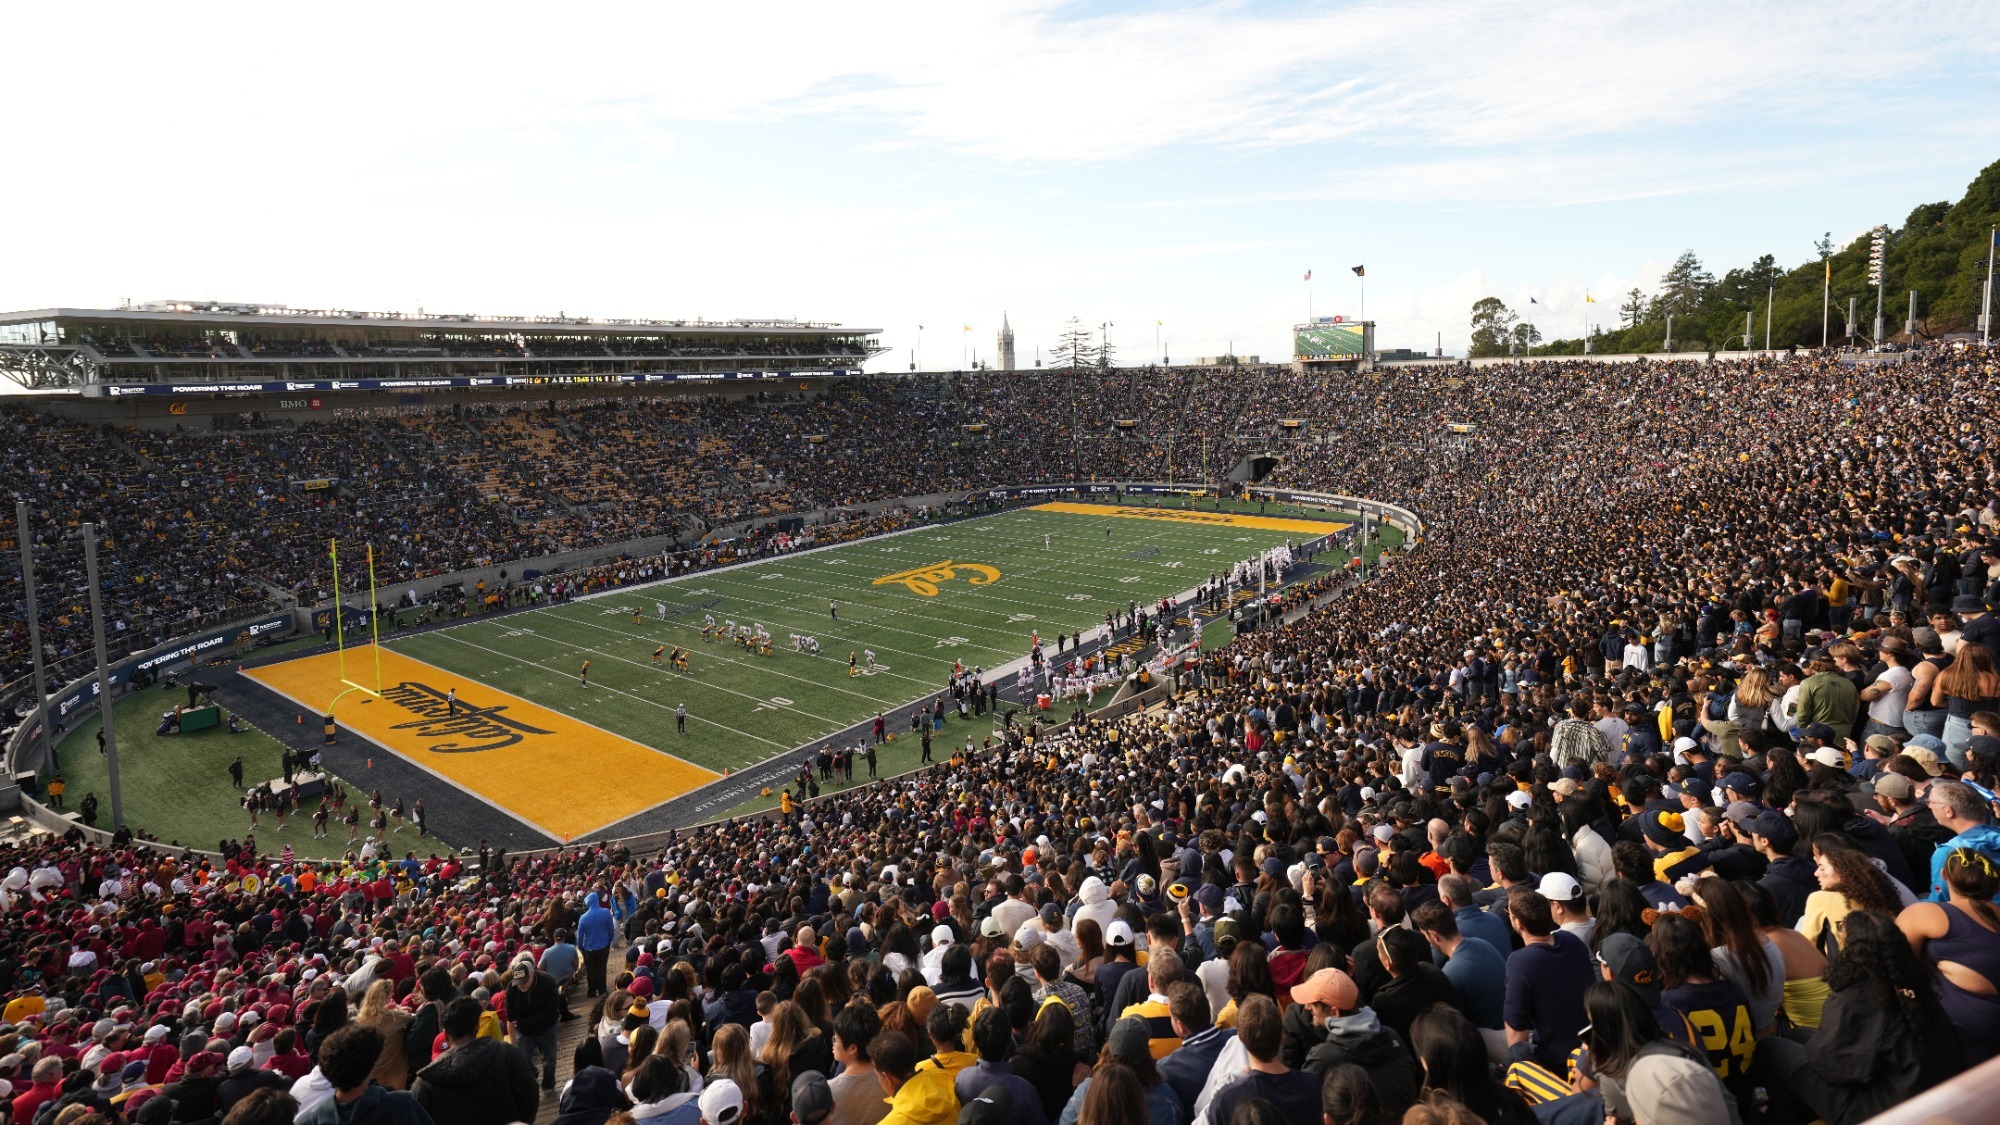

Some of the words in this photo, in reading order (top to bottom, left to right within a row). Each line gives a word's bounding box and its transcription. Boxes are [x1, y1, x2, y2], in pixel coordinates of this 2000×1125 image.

[168, 402, 187, 415] Cal
[280, 399, 307, 409] BMO
[872, 559, 1001, 597] Cal
[197, 637, 223, 650] ROAR!
[757, 696, 794, 710] 10
[1634, 970, 1654, 984] Cal
[1688, 1004, 1757, 1079] 24
